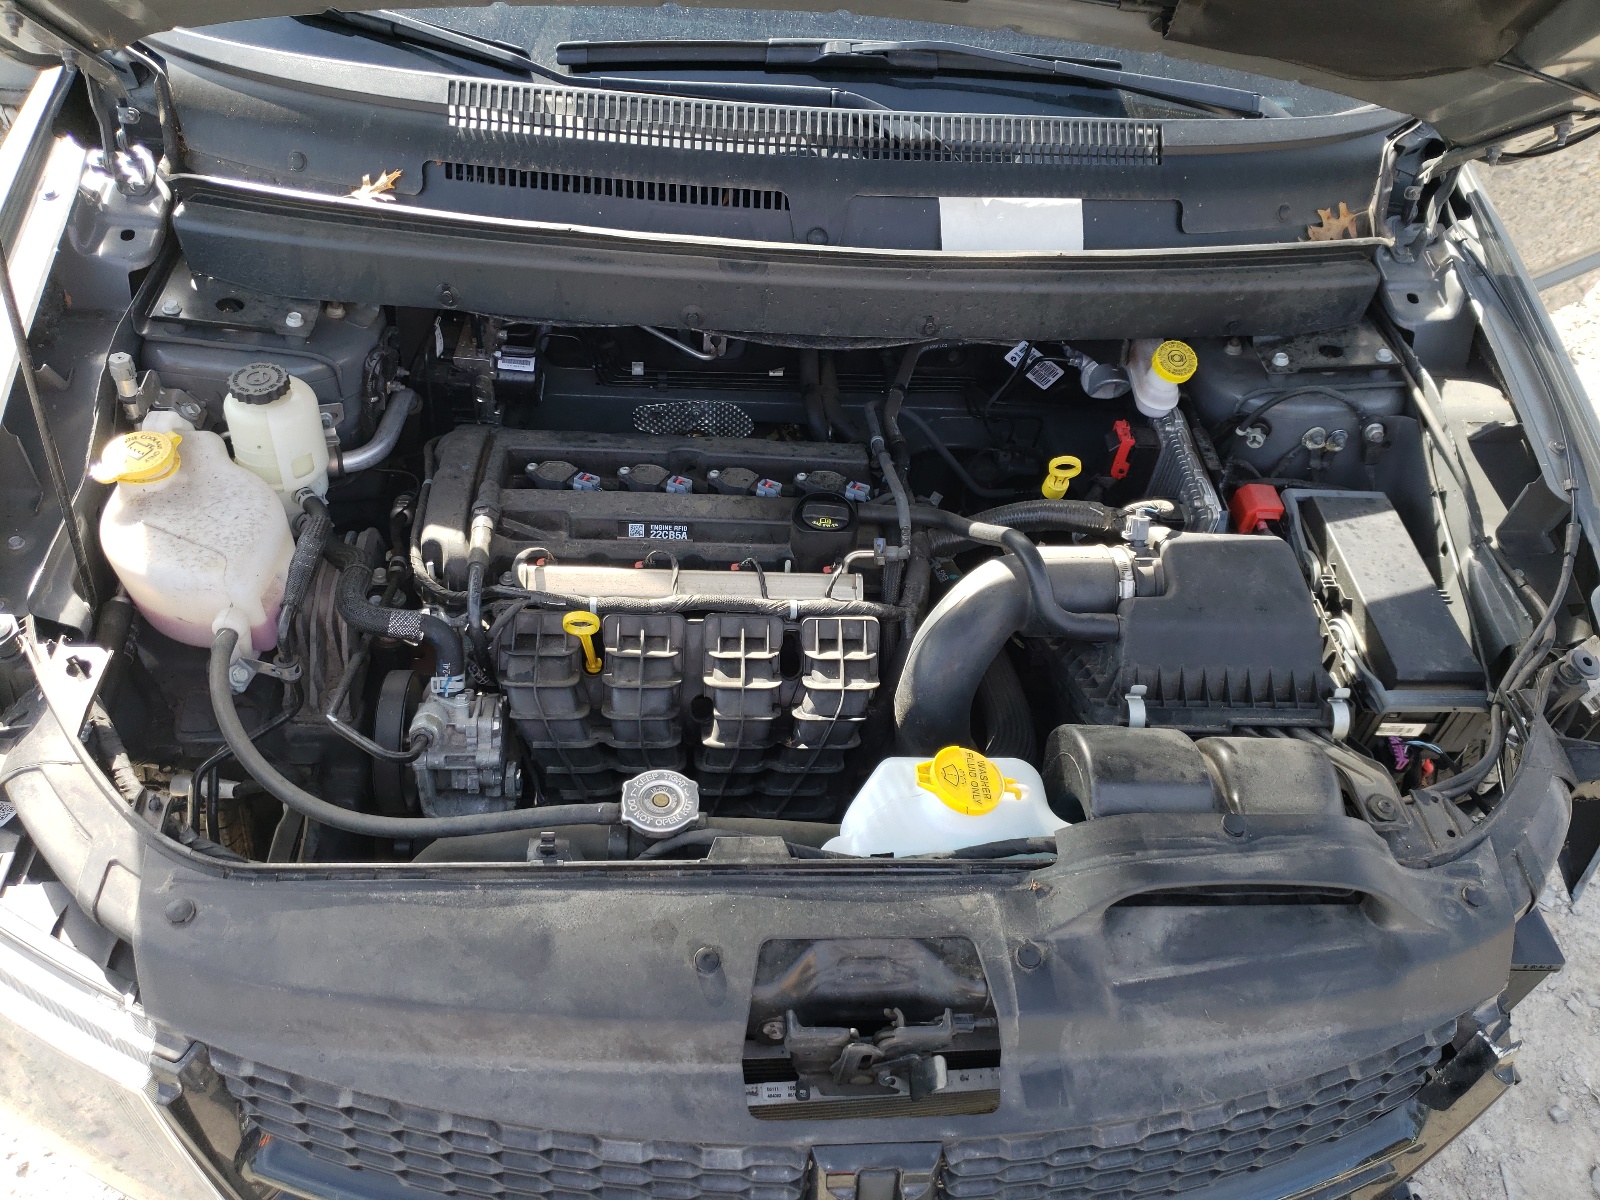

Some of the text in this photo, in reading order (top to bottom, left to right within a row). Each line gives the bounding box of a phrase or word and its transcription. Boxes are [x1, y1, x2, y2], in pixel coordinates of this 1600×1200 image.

[650, 530, 688, 540] 22CB5A
[634, 772, 689, 788] KEEP TIGHT
[965, 752, 982, 805] FLUID ONLY
[977, 760, 992, 800] WASHER
[627, 799, 638, 811] DO
[634, 810, 653, 824] NOT
[655, 814, 683, 826] OPEN
[680, 798, 694, 816] HOT
